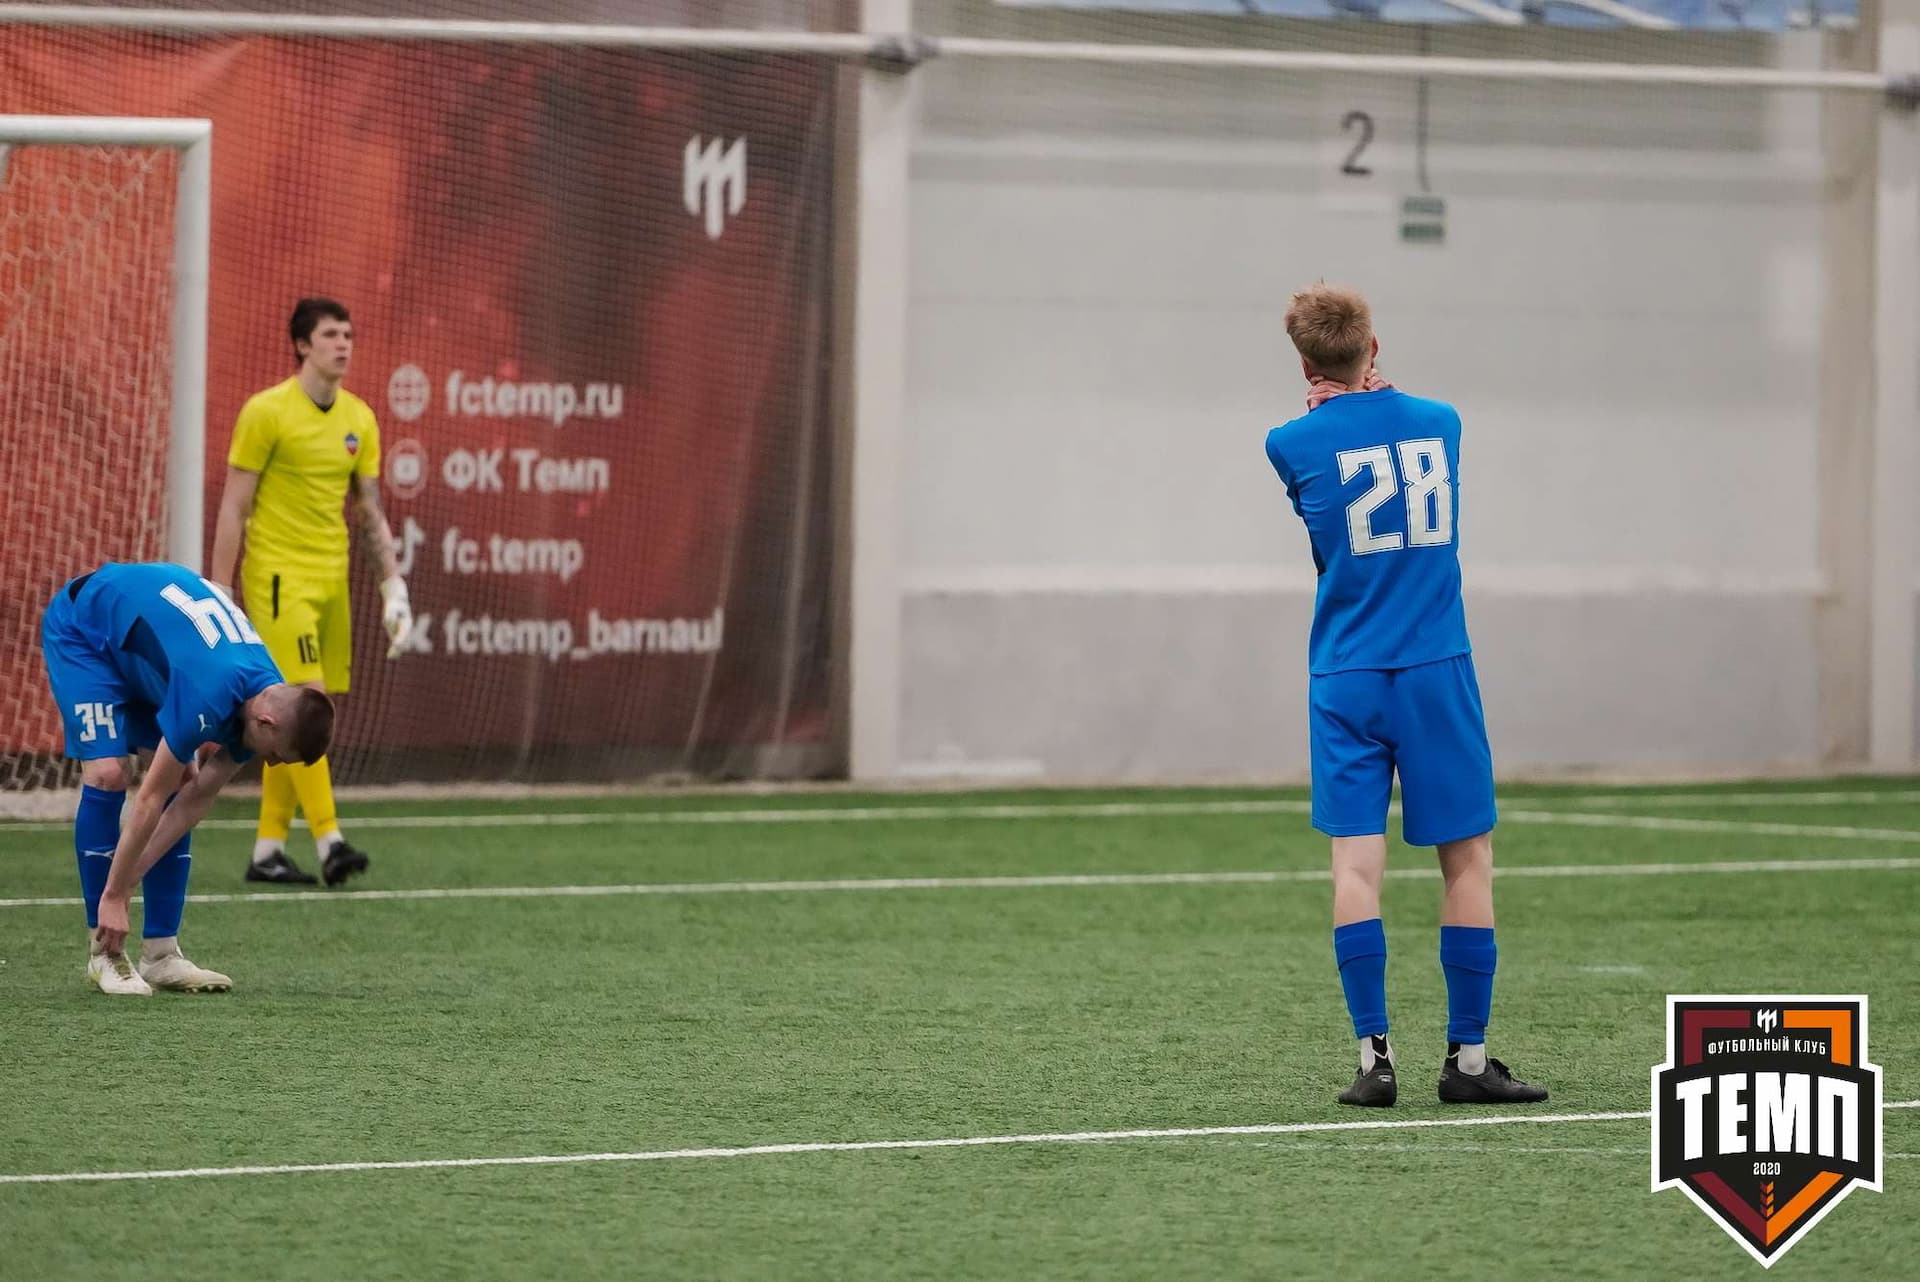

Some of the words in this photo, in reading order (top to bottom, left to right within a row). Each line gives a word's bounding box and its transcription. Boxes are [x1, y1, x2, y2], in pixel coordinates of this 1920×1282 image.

[1340, 110, 1374, 176] 2
[445, 370, 623, 427] fctemp.ru
[443, 449, 503, 491] ФК
[512, 449, 610, 492] Темп
[1336, 437, 1453, 556] 28
[442, 527, 584, 583] fc.temp
[444, 606, 724, 663] fctemp_barnaul
[74, 702, 117, 742] 34
